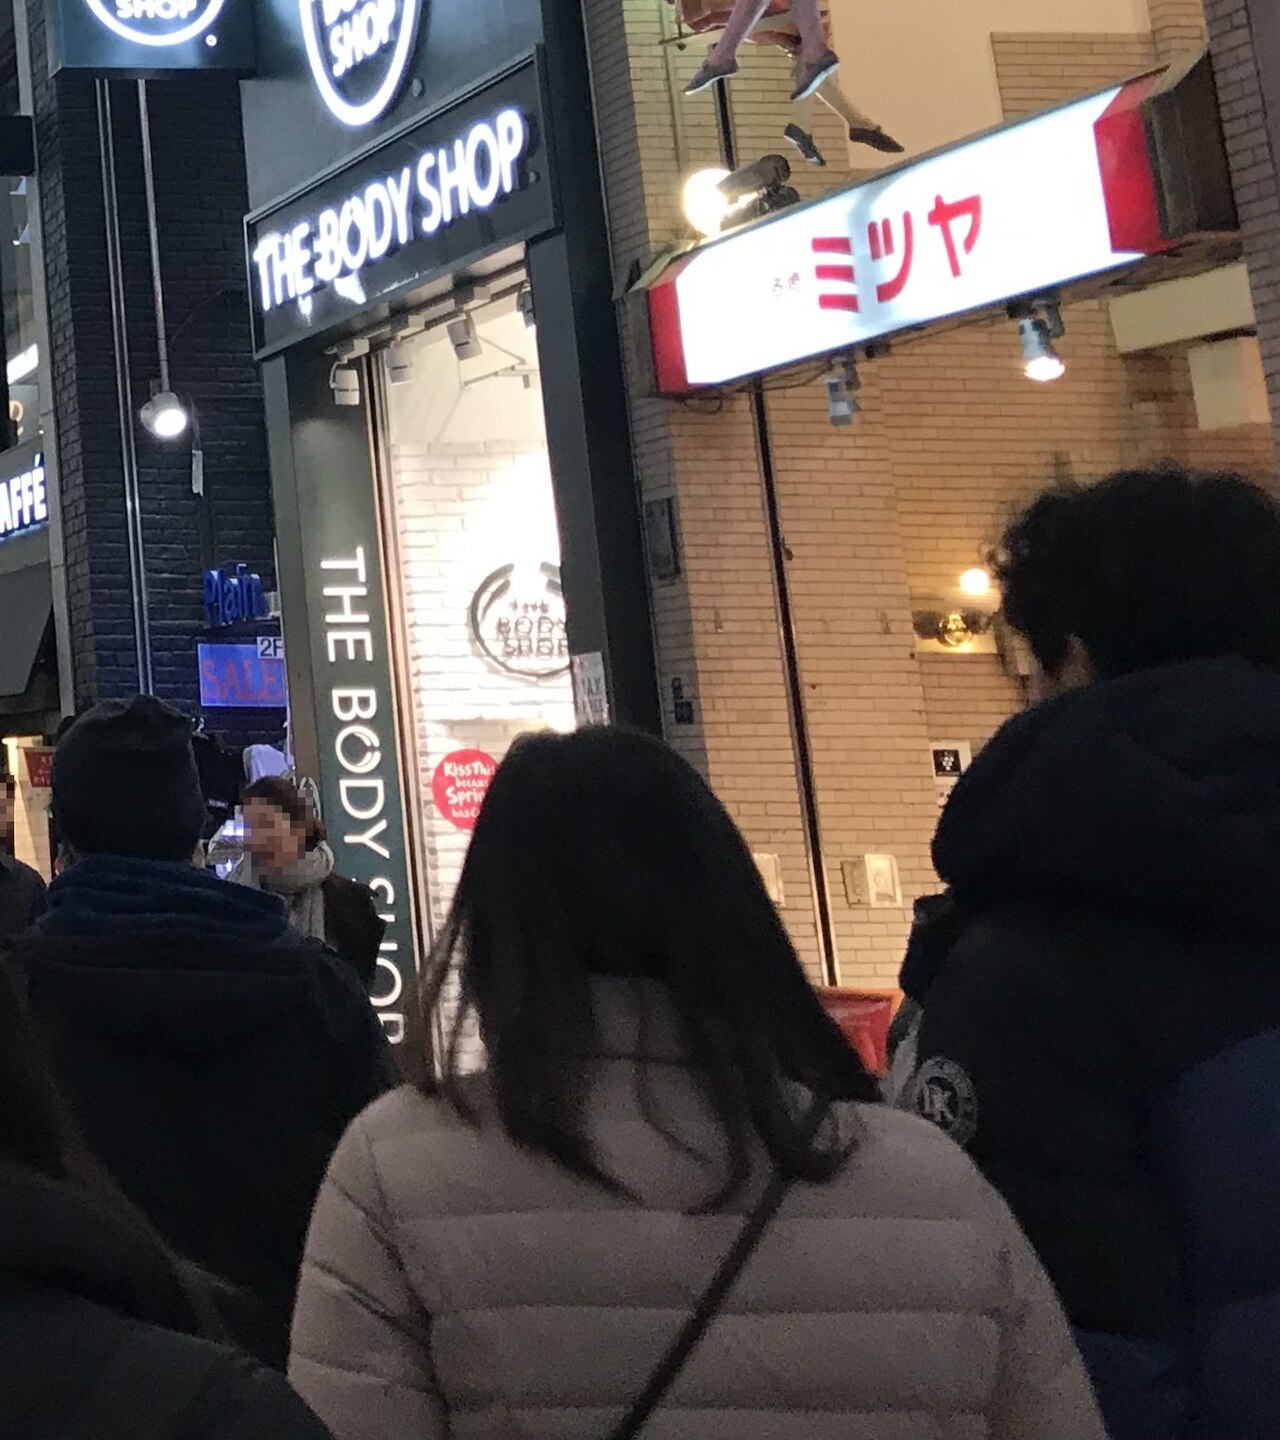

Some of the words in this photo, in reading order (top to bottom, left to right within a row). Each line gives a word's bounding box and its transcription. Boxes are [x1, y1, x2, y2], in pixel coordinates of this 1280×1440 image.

[252, 223, 314, 313] THE
[313, 166, 414, 283] BODY
[416, 108, 524, 231] SHOP
[811, 194, 983, 313] ミツヤ
[319, 546, 374, 664] THE
[202, 657, 282, 702] SALE
[331, 687, 391, 859] BODY
[443, 760, 471, 777] Kiss
